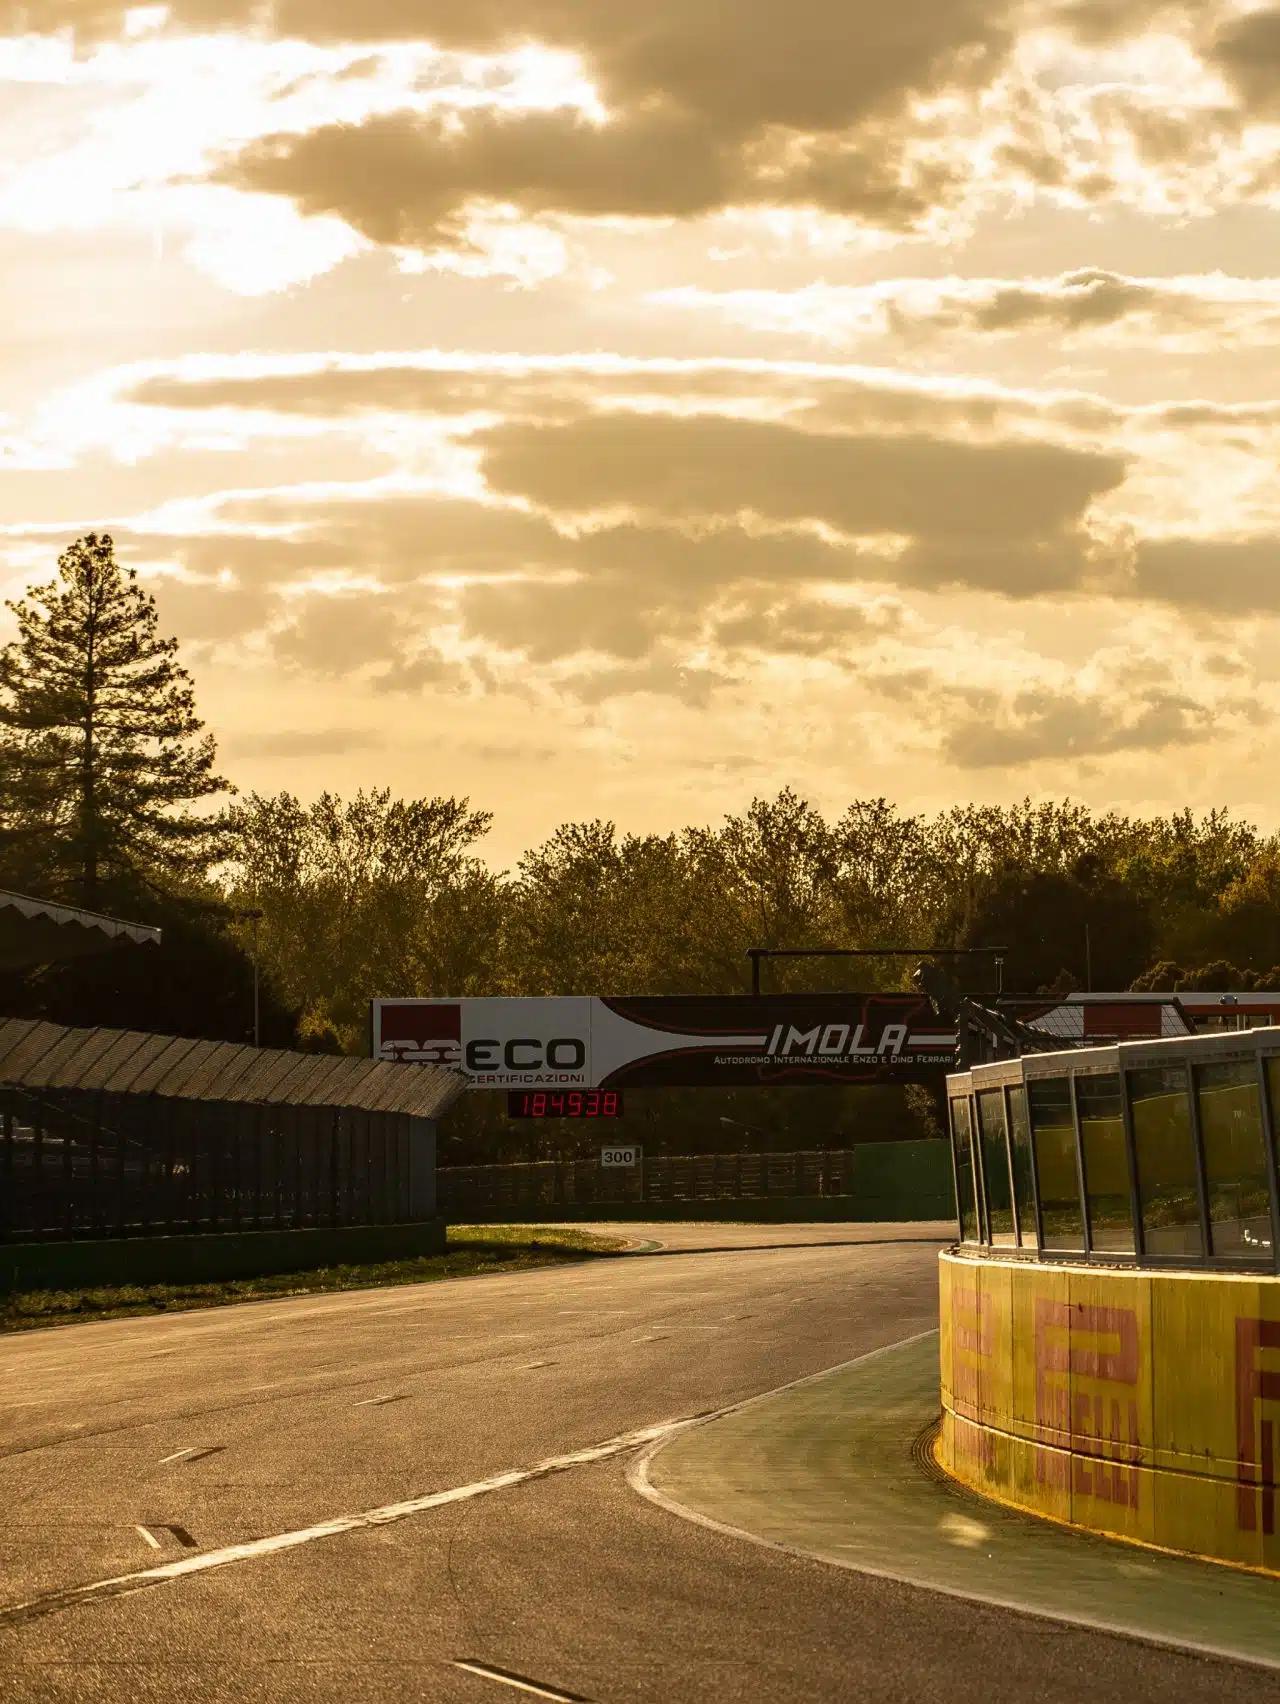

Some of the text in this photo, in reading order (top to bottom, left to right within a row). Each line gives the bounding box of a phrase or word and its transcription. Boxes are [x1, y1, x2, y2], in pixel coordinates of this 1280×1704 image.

[766, 1024, 908, 1055] IMOLA
[465, 1038, 586, 1070] ECO
[713, 1054, 770, 1064] AUTODROMO
[774, 1054, 850, 1064] INTERNAZIONALE
[853, 1054, 879, 1064] ENZO
[890, 1054, 913, 1064] DINO
[916, 1054, 955, 1063] FERRARI
[524, 1093, 618, 1117] 184938
[604, 1152, 633, 1163] 300
